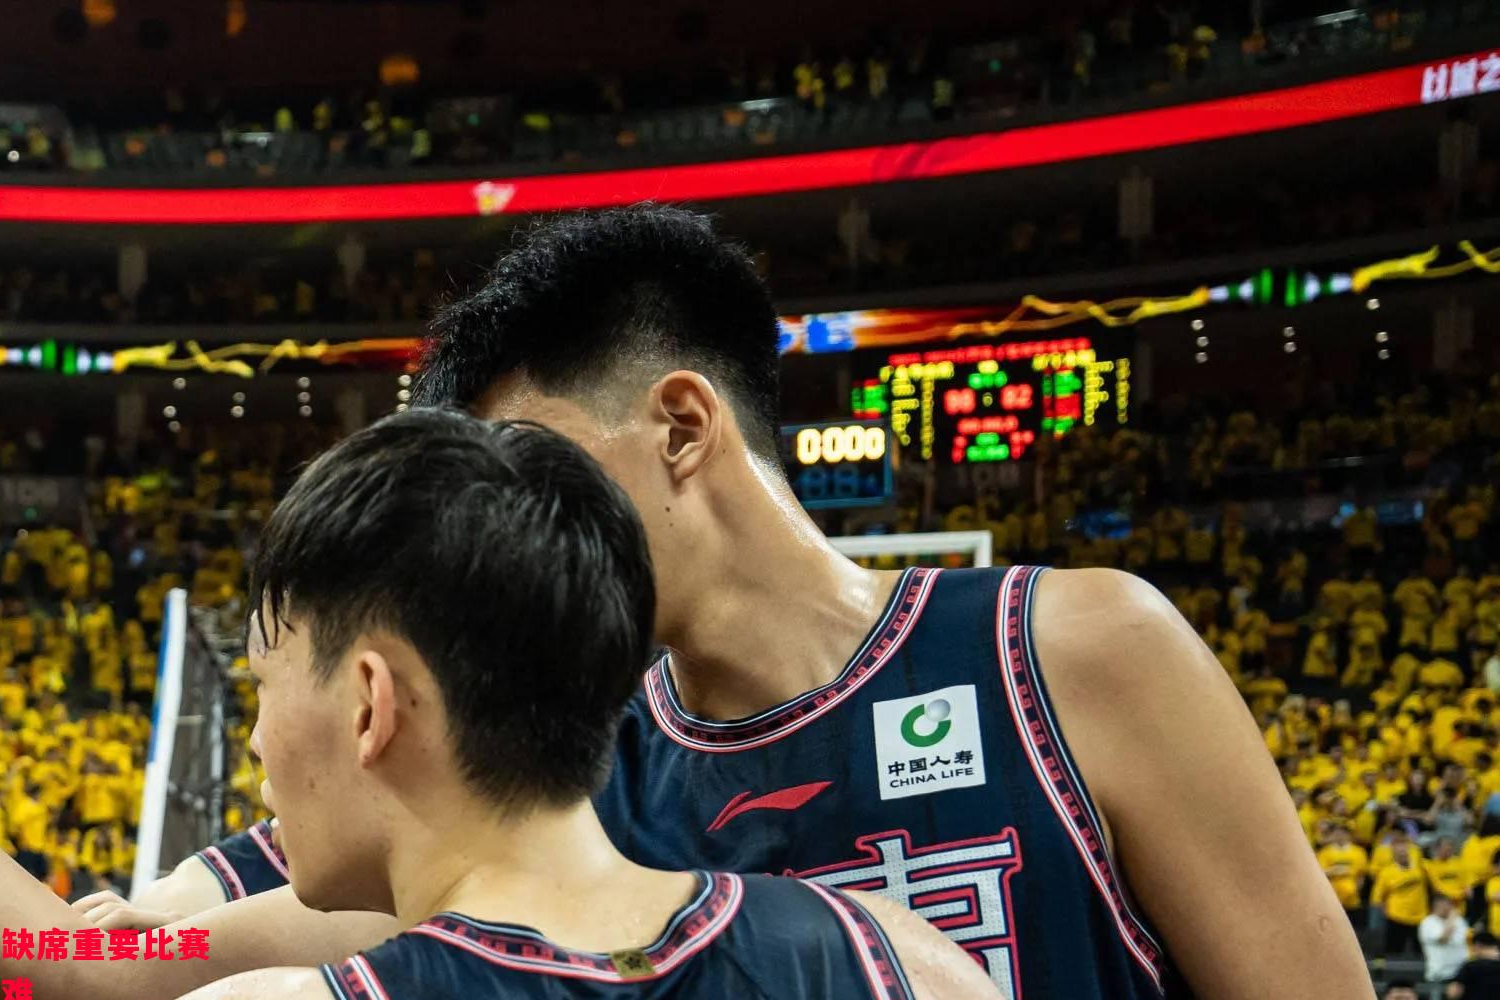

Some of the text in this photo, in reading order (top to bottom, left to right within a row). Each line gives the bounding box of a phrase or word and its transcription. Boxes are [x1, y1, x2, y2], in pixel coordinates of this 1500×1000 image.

[888, 750, 974, 776] 中国人寿
[890, 767, 974, 788] CHINA LIFE
